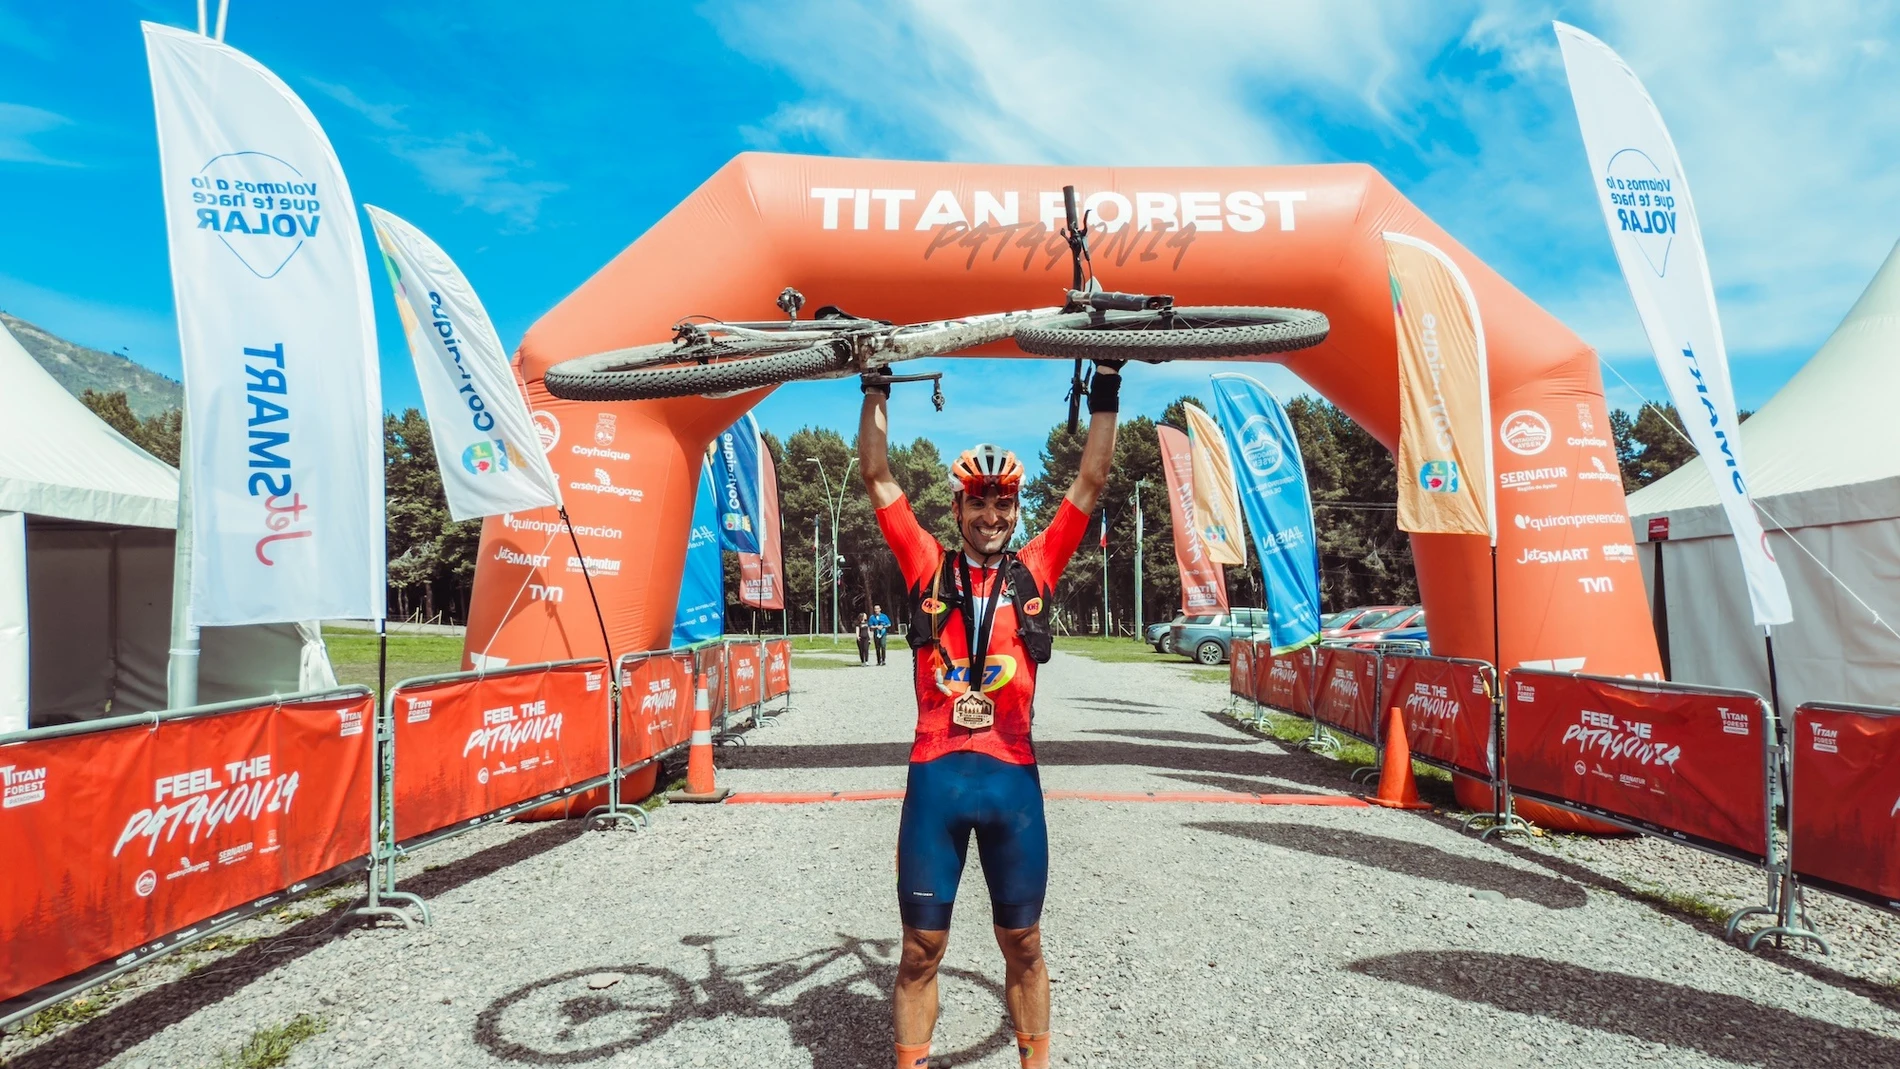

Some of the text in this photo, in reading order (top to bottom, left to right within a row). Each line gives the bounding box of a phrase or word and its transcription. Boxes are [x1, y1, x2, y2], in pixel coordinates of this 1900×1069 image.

[811, 187, 1307, 232] TITAN FOREST
[924, 221, 1198, 271] PATAGONIA
[572, 445, 631, 461] Coyhaique
[1500, 466, 1568, 484] SERNATUR
[494, 545, 551, 567] JetSMART
[1517, 548, 1589, 564] JetSMART
[944, 665, 1002, 685] K-7
[1415, 682, 1448, 698] FEEL THE
[483, 700, 546, 726] FEEL THE
[1581, 710, 1620, 730] FEEL
[1717, 707, 1748, 721] TITAN
[1723, 720, 1749, 728] FOREST
[1810, 722, 1838, 738] TITAN
[463, 713, 562, 759] PATAGONIA
[1562, 724, 1681, 774] PATAGONIA
[0, 764, 46, 787] TITAN
[156, 754, 271, 803] FEEL THE
[4, 780, 46, 797] FOREST
[113, 771, 299, 858] PATAGONIA
[218, 842, 253, 860] SERNATUR
